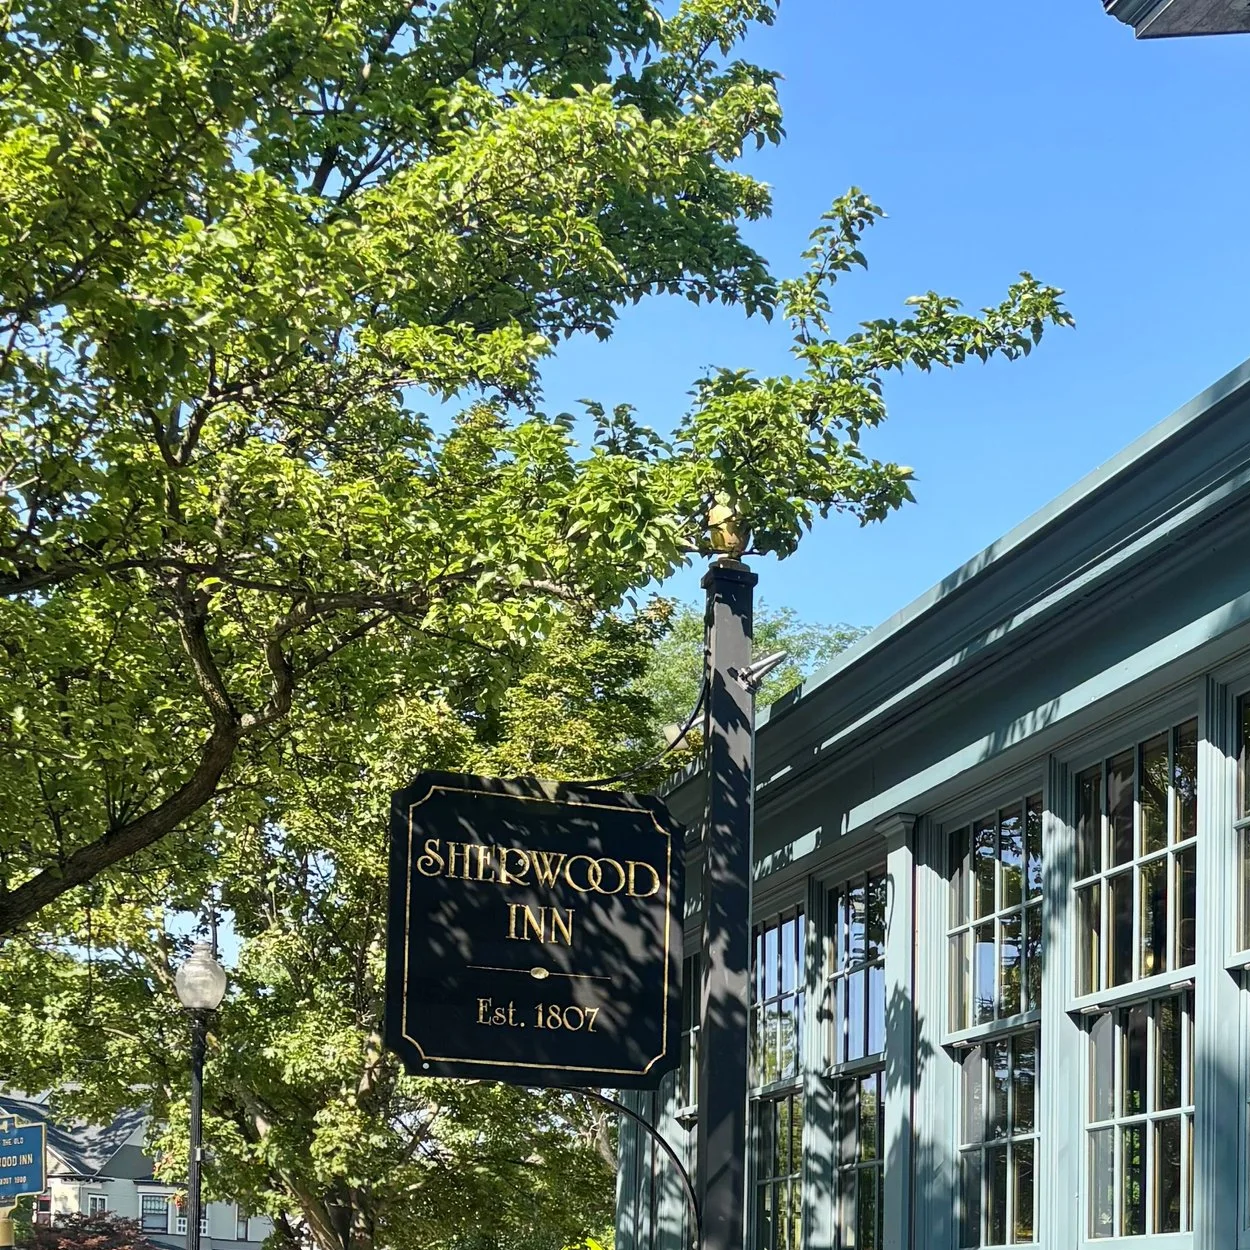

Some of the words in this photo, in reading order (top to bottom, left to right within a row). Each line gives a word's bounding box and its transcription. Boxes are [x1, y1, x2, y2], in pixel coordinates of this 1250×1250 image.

[416, 838, 661, 898] SHERWOOD
[505, 902, 575, 946] INN
[476, 997, 525, 1027] Est.
[534, 1002, 600, 1033] 1807
[0, 1156, 17, 1168] OOD
[19, 1153, 33, 1165] INN
[2, 1139, 12, 1147] THE
